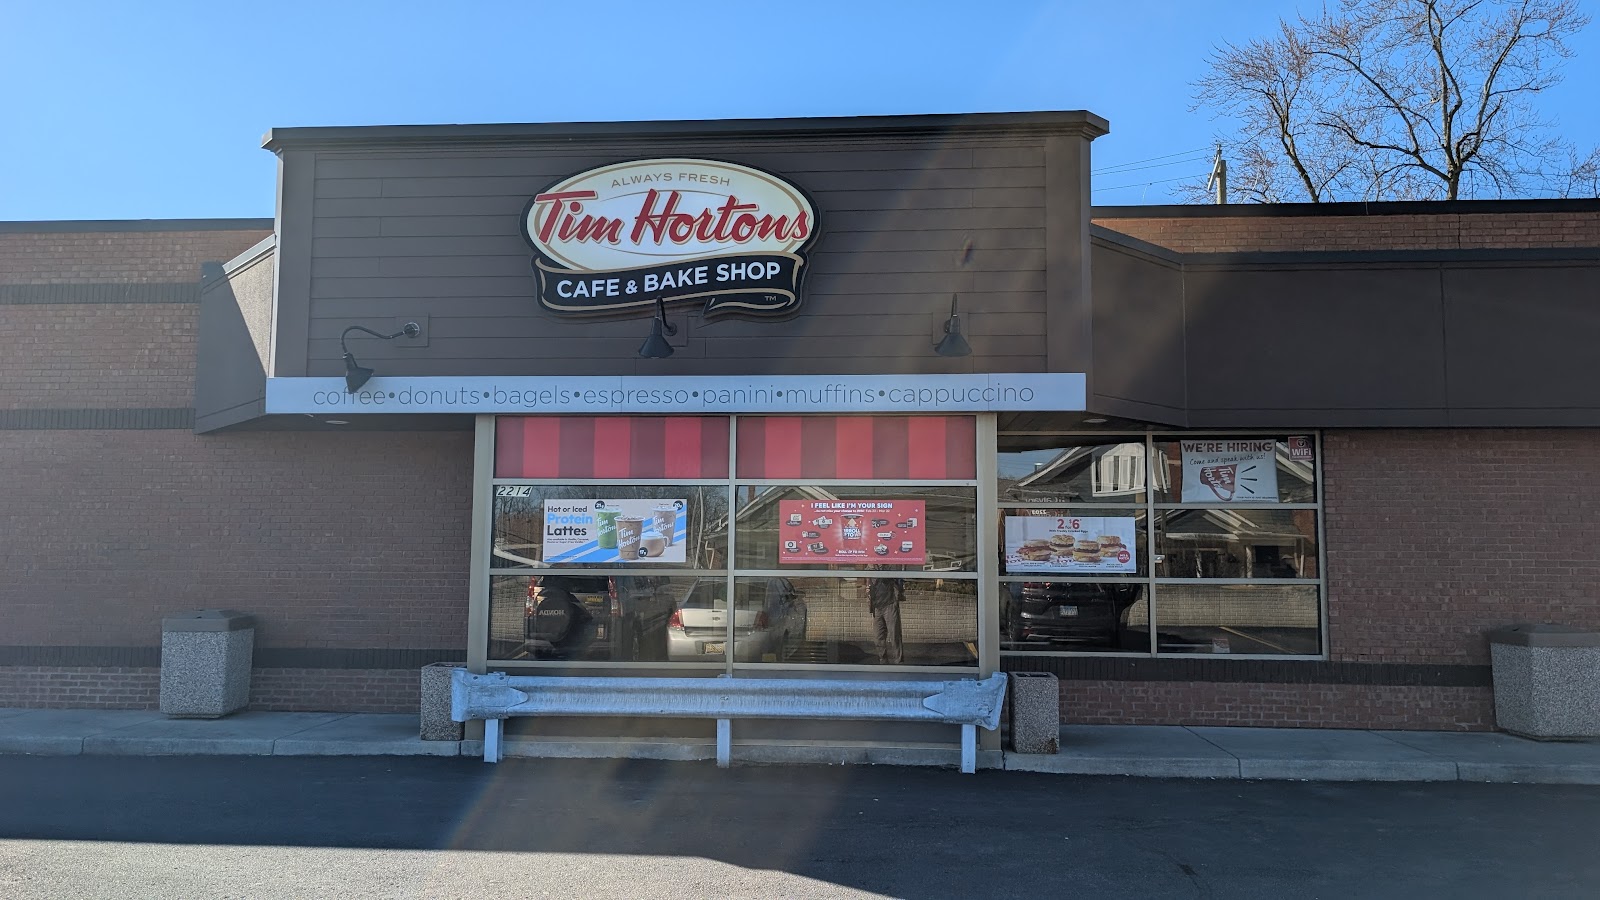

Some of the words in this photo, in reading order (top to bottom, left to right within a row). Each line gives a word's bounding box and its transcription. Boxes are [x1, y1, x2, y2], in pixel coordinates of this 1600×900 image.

[611, 173, 673, 188] ALWAYS
[678, 173, 730, 186] FRESH
[535, 190, 624, 244] Tim
[630, 188, 811, 245] Hortons
[556, 279, 620, 298] CAFE
[625, 280, 638, 294] &
[644, 266, 708, 292] BAKE
[716, 262, 781, 281] SHOP
[313, 385, 386, 405] coffee
[398, 385, 480, 405] donuts
[494, 385, 570, 408] bagels
[583, 389, 689, 407] espresso
[703, 384, 773, 407] panini
[785, 383, 875, 403] muffins
[888, 382, 1034, 406] cappuccino
[1182, 442, 1223, 452] WE'RE
[1226, 442, 1273, 452] HIRING
[1190, 458, 1205, 466] Come
[1221, 455, 1239, 464] speak
[1256, 452, 1266, 460] us!
[1218, 466, 1234, 484] Tim
[497, 486, 532, 496] 2214
[547, 514, 593, 524] Protein
[1057, 519, 1064, 529] 2
[547, 525, 587, 536] Lattes
[619, 528, 634, 538] Tim
